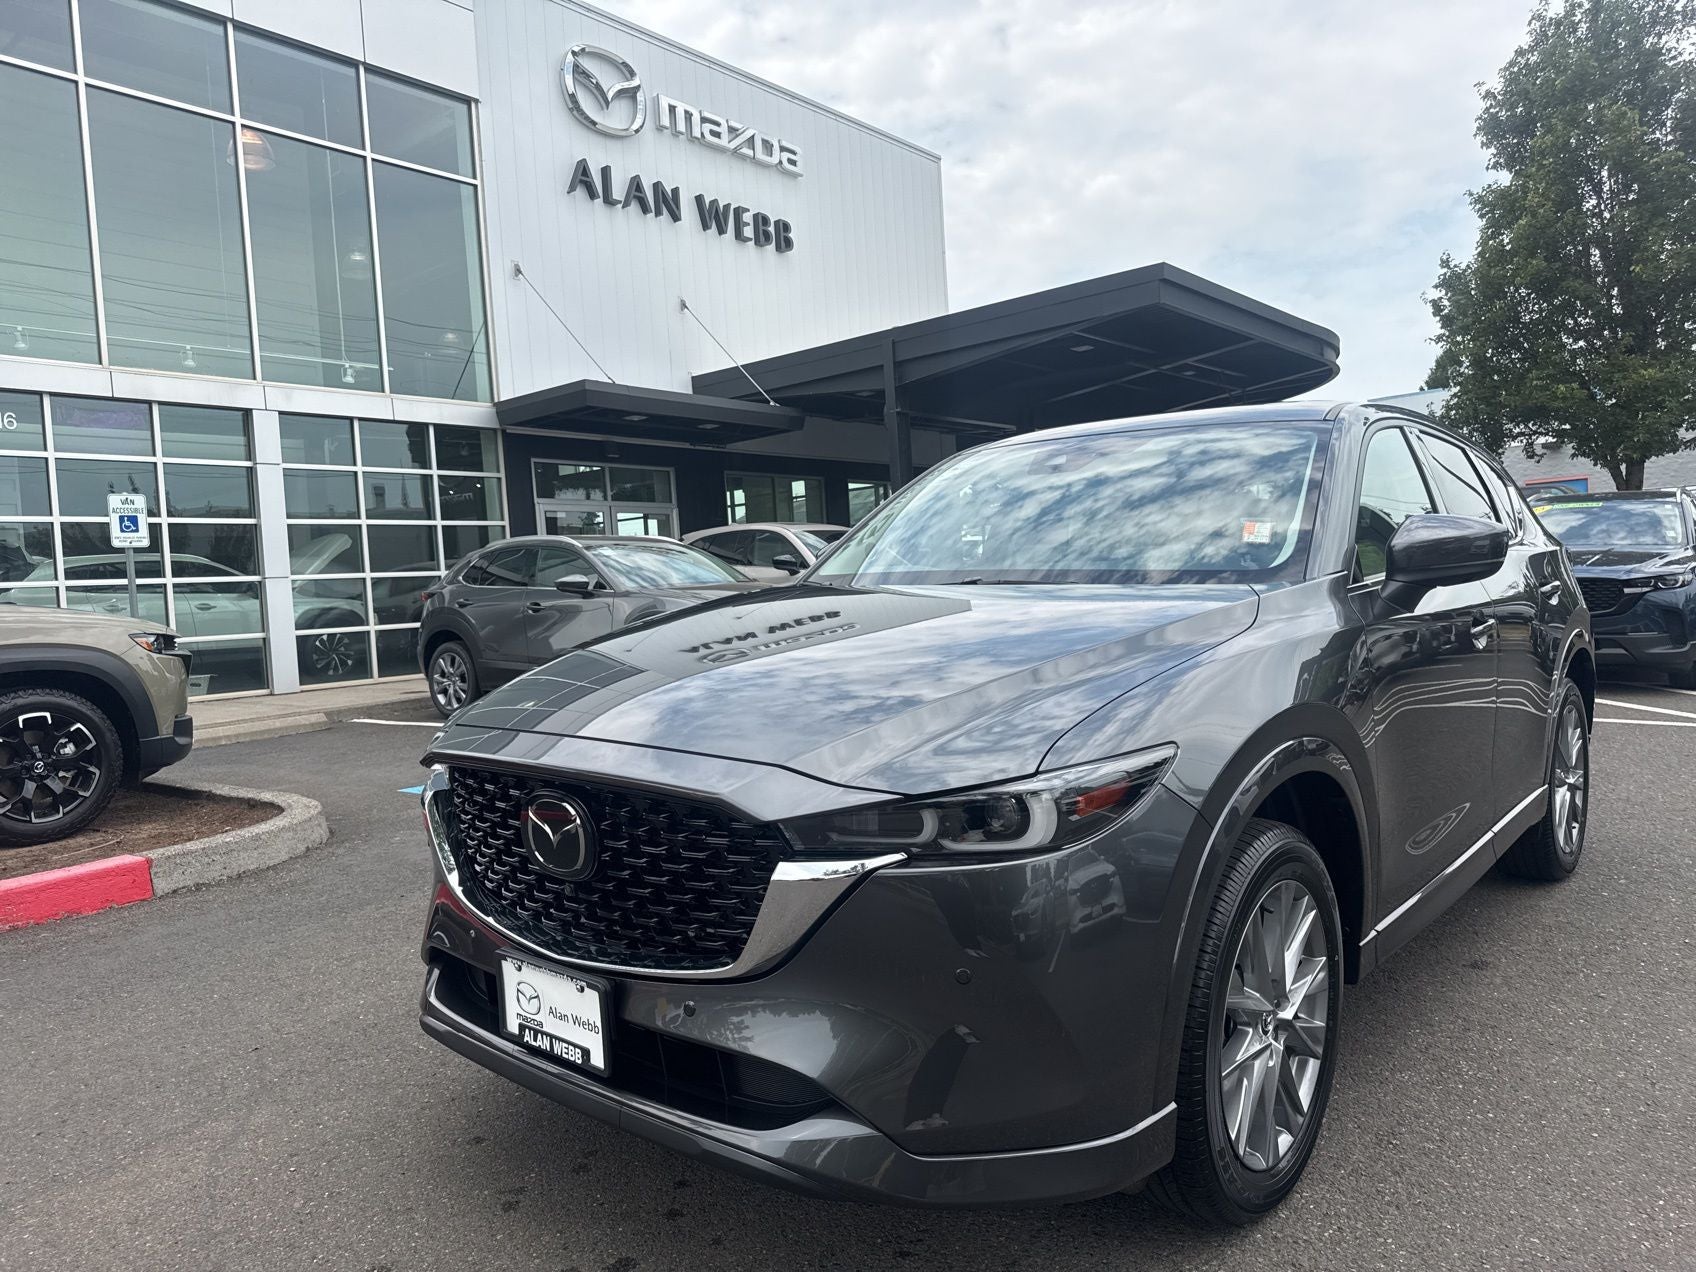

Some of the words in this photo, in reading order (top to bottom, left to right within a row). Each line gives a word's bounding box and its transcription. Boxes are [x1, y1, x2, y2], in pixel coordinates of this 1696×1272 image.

[655, 93, 803, 178] mazda
[567, 158, 681, 223] ALAN
[695, 193, 794, 253] WEBB
[111, 507, 145, 515] ACCESSIBLE
[120, 497, 135, 506] VAN
[516, 1012, 544, 1029] mazda
[548, 1005, 570, 1024] Alan
[571, 1012, 600, 1035] Webb
[524, 1028, 550, 1052] ALAN
[552, 1038, 582, 1064] WEBB
